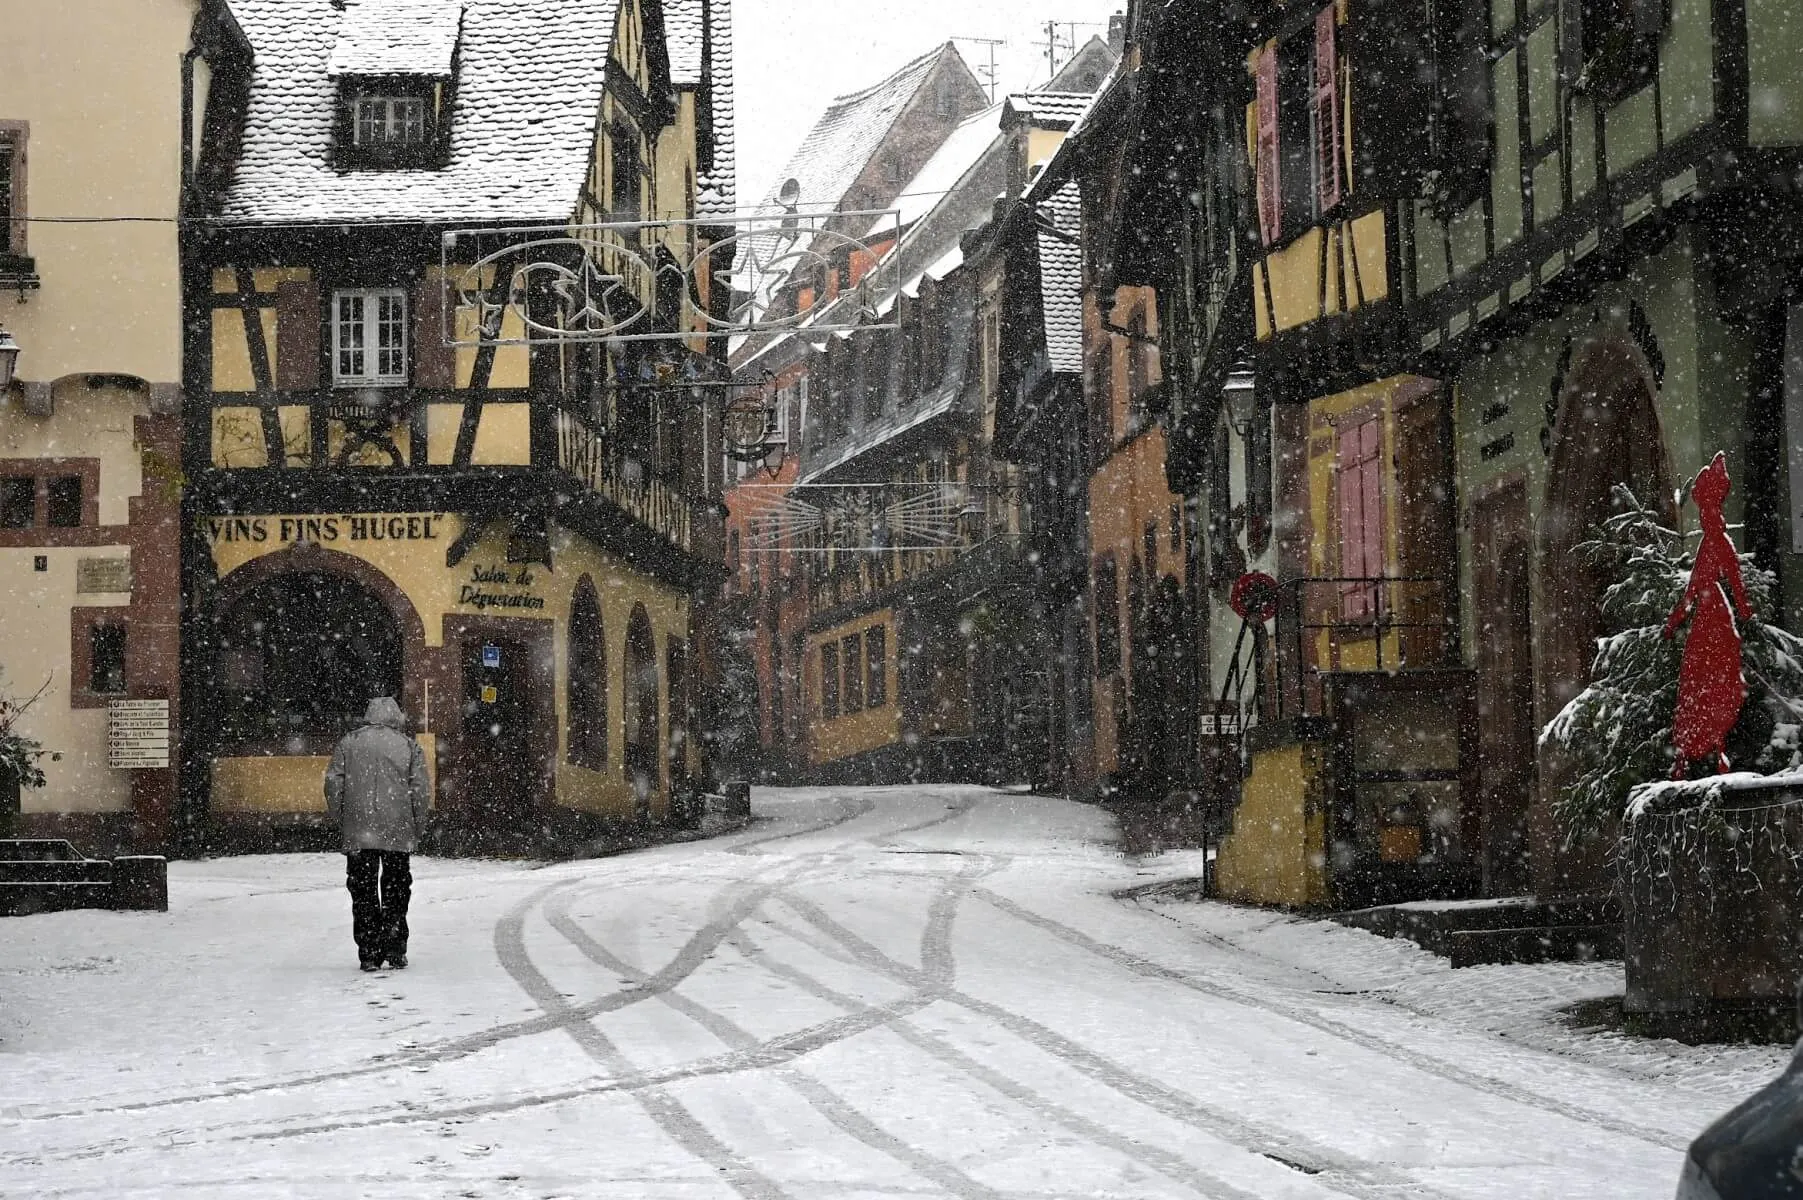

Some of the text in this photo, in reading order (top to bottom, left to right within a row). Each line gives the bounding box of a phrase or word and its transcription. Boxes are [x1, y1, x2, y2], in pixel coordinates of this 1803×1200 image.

[208, 517, 268, 542] VINS
[279, 517, 339, 542] FINS
[470, 564, 534, 585] Salon de
[458, 585, 545, 609] Dégustation
